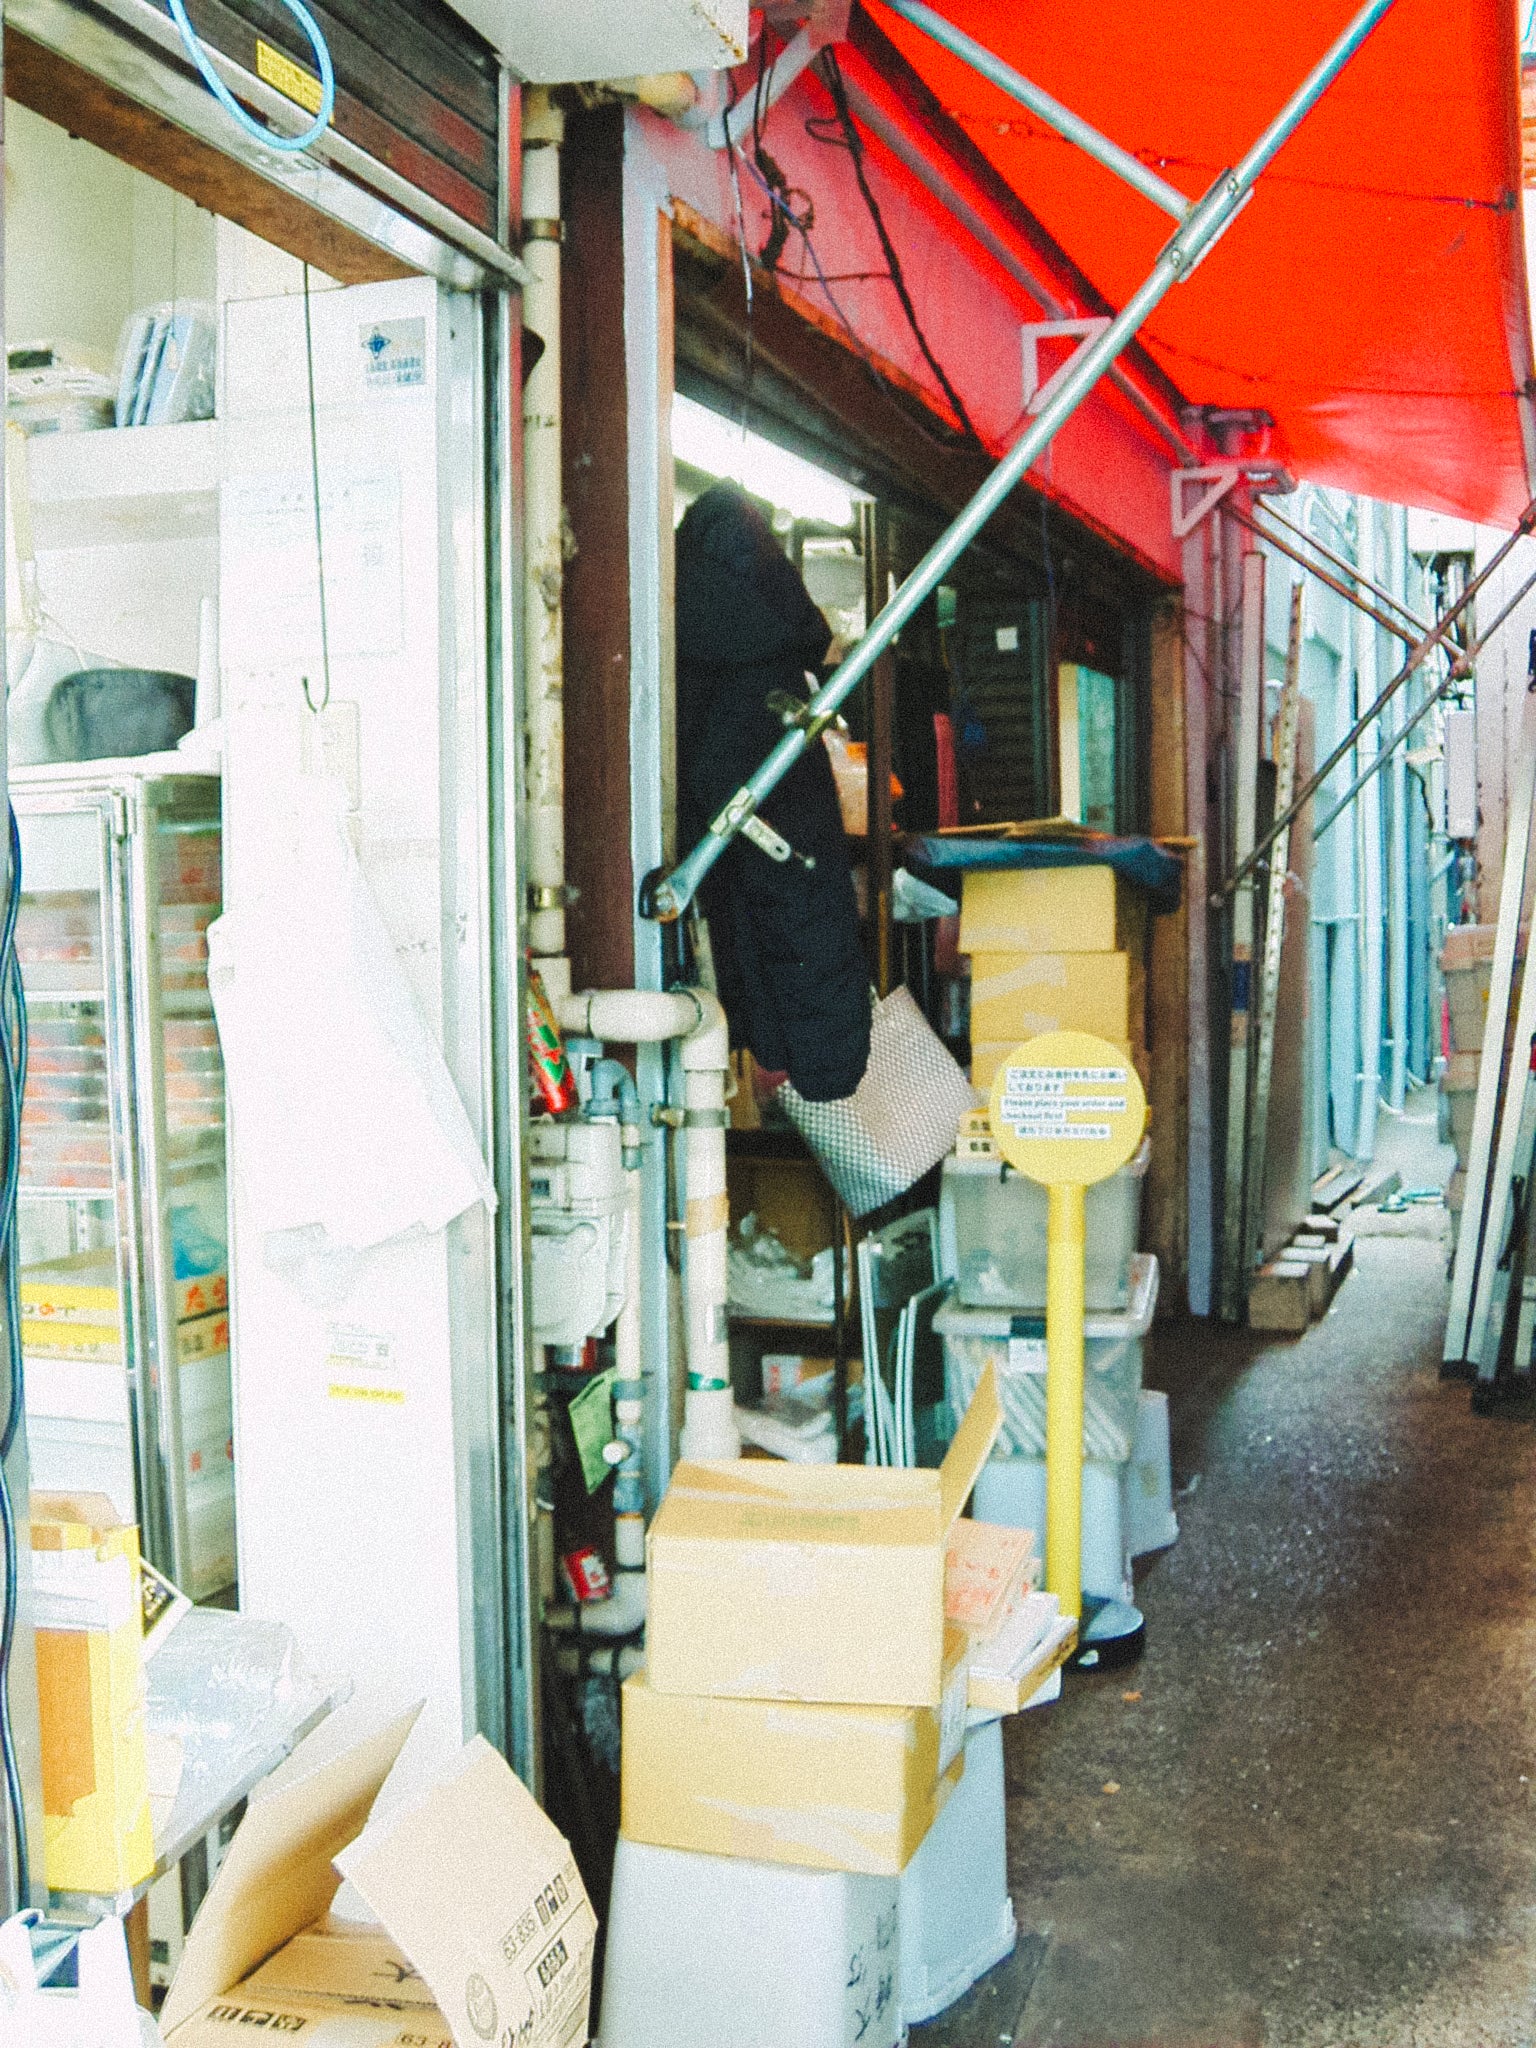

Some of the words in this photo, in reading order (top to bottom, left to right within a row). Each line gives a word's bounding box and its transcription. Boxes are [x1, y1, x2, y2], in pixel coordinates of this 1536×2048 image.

[1004, 1099, 1032, 1107] Please
[1034, 1099, 1057, 1108] place
[1060, 1100, 1079, 1108] your
